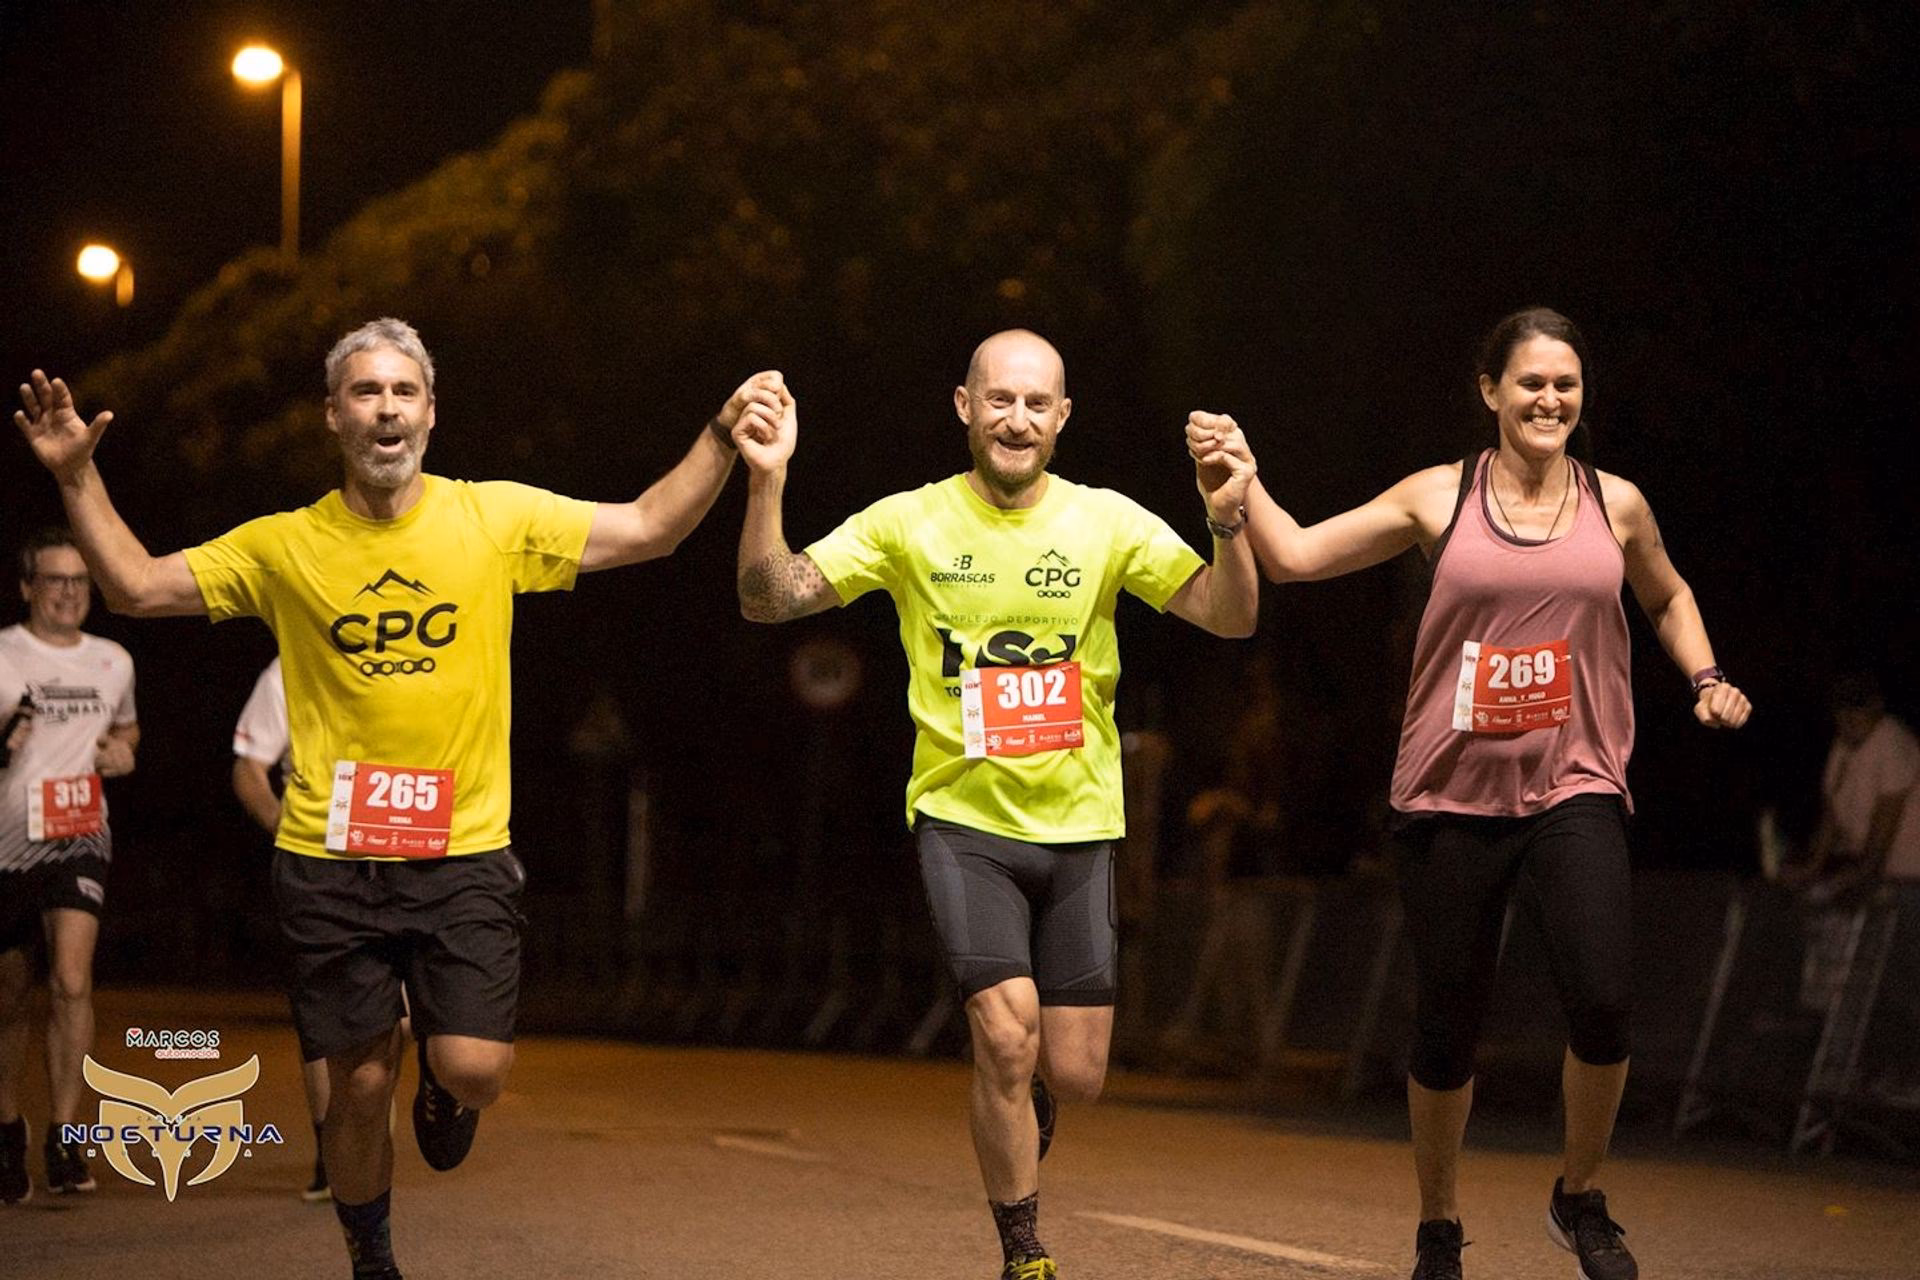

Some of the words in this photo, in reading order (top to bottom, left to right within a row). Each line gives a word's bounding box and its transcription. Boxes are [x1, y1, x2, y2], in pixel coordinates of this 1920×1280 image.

[930, 572, 996, 583] BORRASCAS
[1025, 567, 1082, 587] CPG
[330, 603, 459, 654] CPG
[1006, 615, 1078, 625] DEPORTIVO
[1488, 649, 1556, 688] 269
[996, 669, 1067, 709] 302
[54, 778, 91, 809] 313
[366, 770, 439, 812] 265
